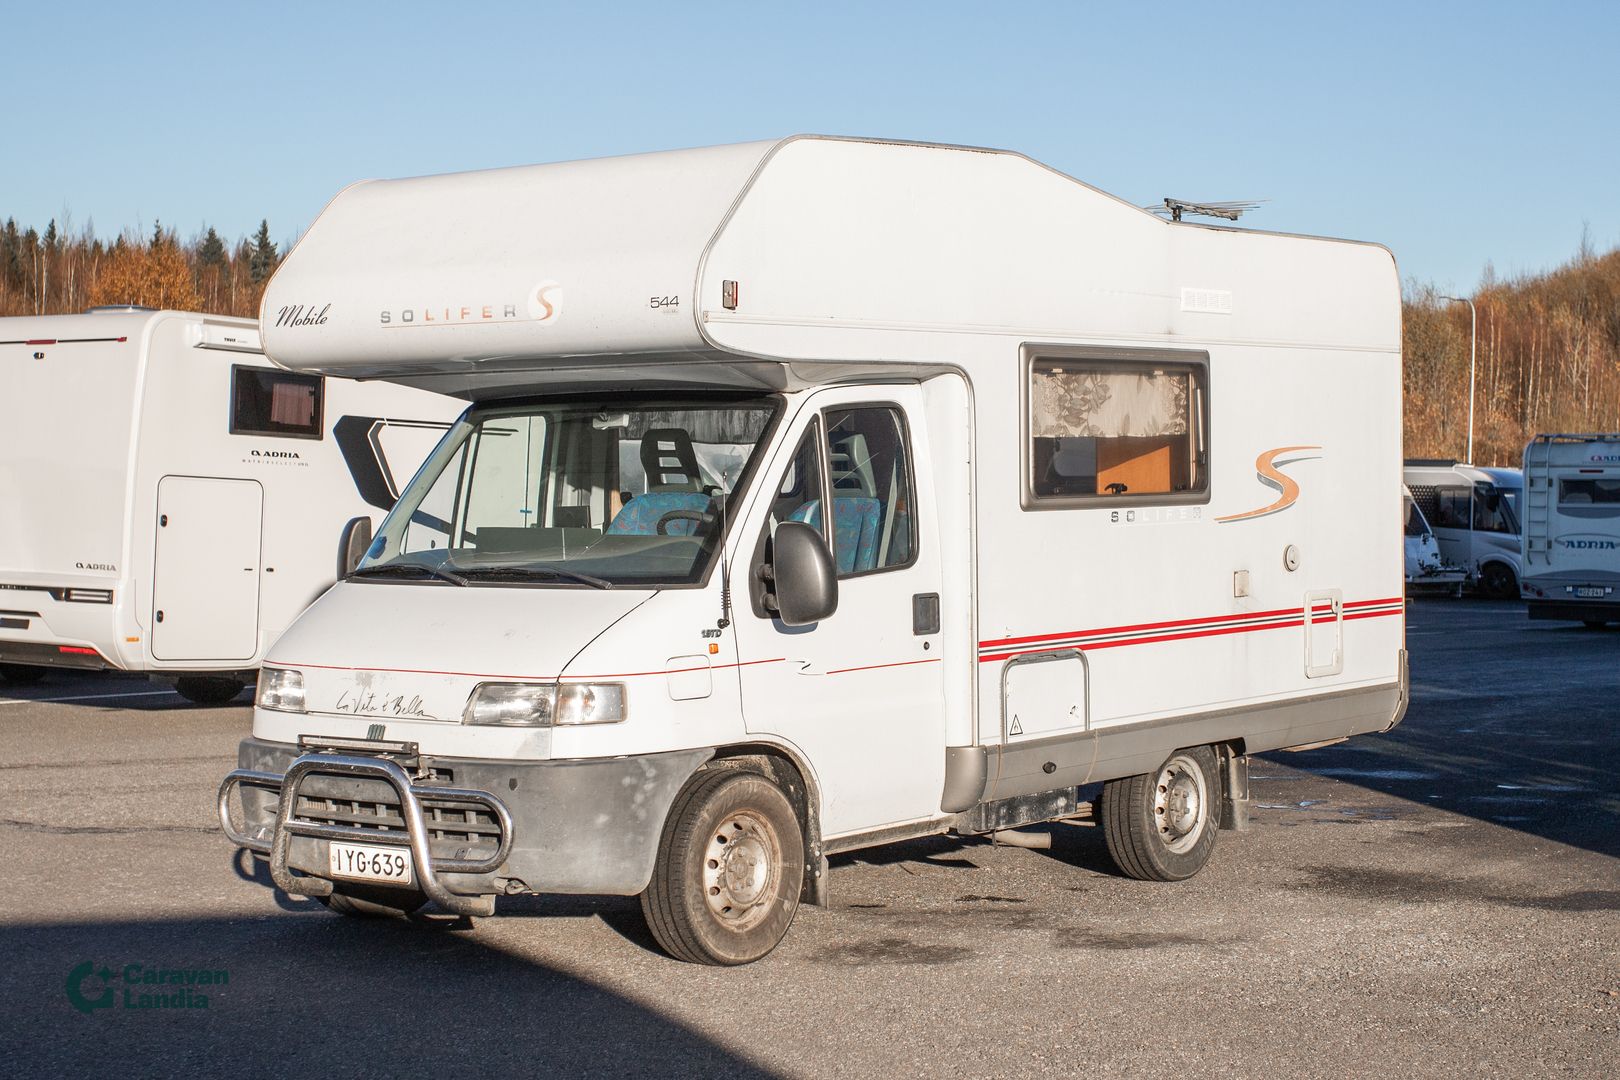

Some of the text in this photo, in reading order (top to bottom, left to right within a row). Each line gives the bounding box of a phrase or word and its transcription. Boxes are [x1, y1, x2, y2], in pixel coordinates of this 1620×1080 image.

[650, 295, 680, 309] 544
[275, 303, 331, 328] Mobile
[380, 304, 516, 324] SOLIFER
[263, 450, 300, 459] ADRIA
[1565, 540, 1616, 550] ADRIA
[86, 563, 117, 572] ADRIA
[390, 695, 438, 720] Bella
